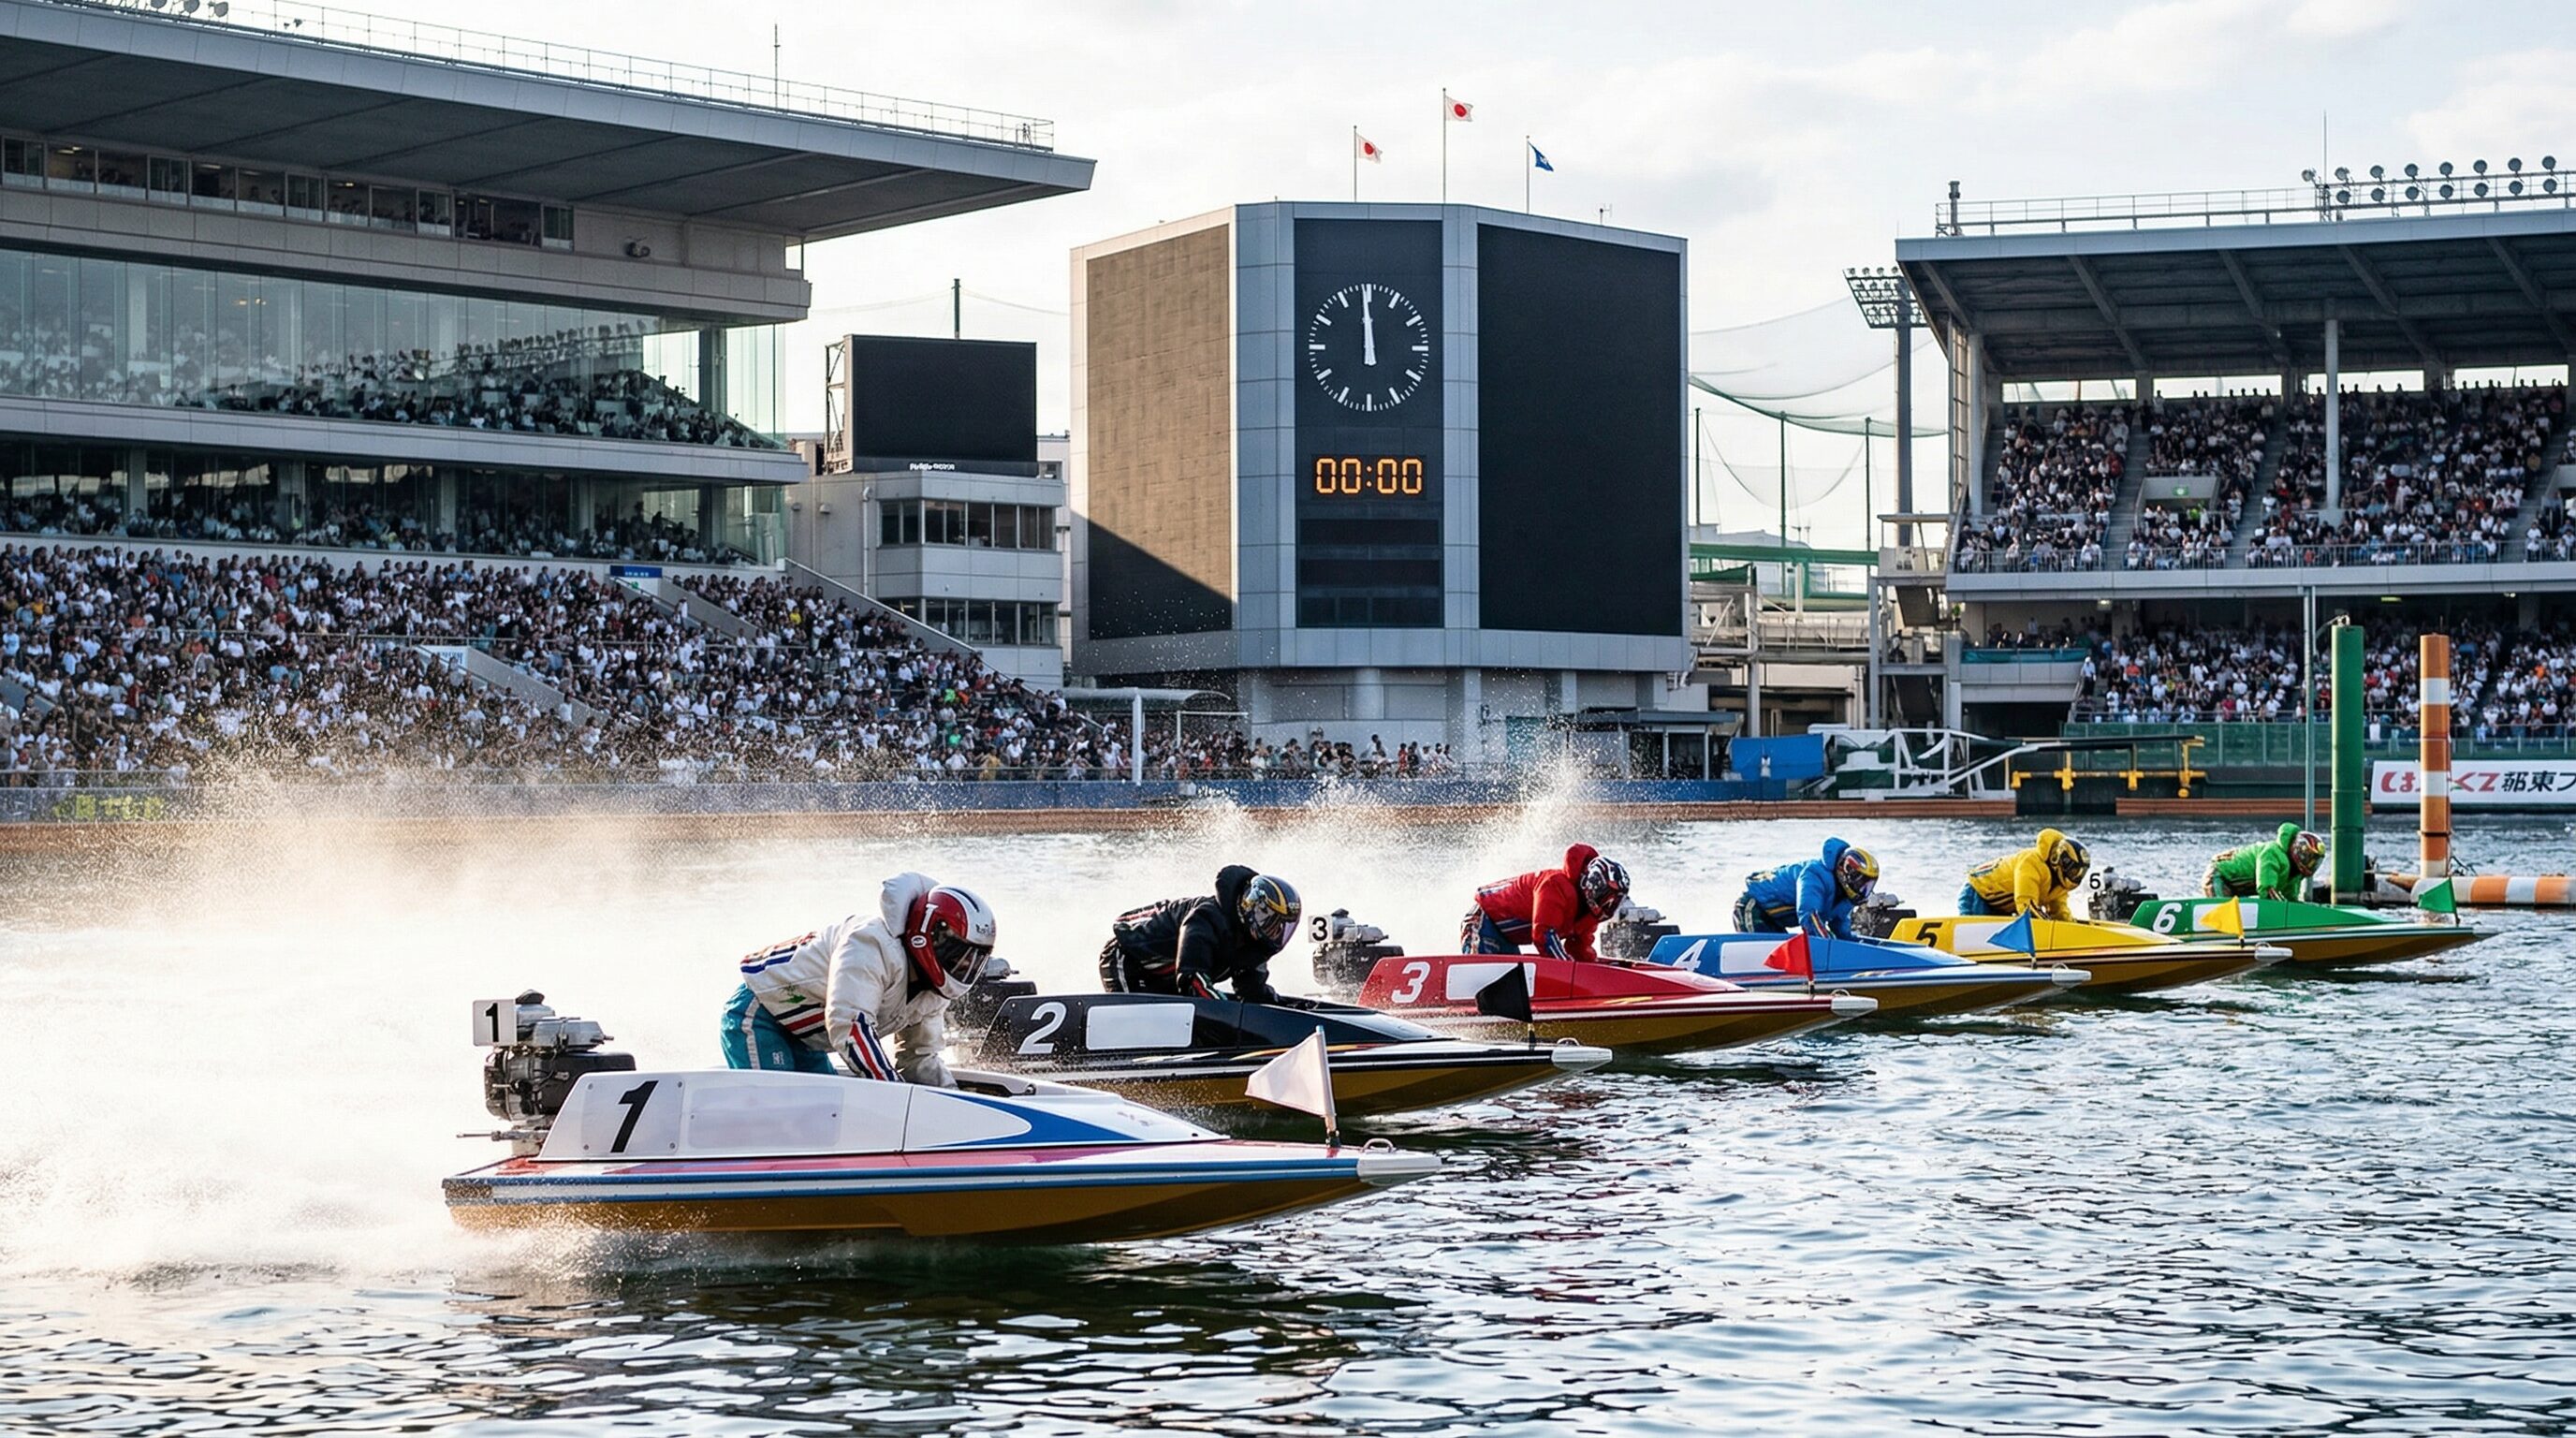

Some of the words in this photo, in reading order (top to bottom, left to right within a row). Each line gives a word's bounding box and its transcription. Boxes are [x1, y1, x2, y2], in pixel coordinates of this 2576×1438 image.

[1316, 458, 1422, 494] 00:00
[2089, 873, 2101, 889] 6
[1312, 917, 1328, 942] 3
[2153, 902, 2182, 933] 6
[1915, 922, 1943, 948] 5
[1672, 939, 1708, 971] 4
[1391, 961, 1431, 1004] 3
[485, 1002, 499, 1043] 1
[1017, 1002, 1067, 1054] 2
[610, 1079, 660, 1153] 1
